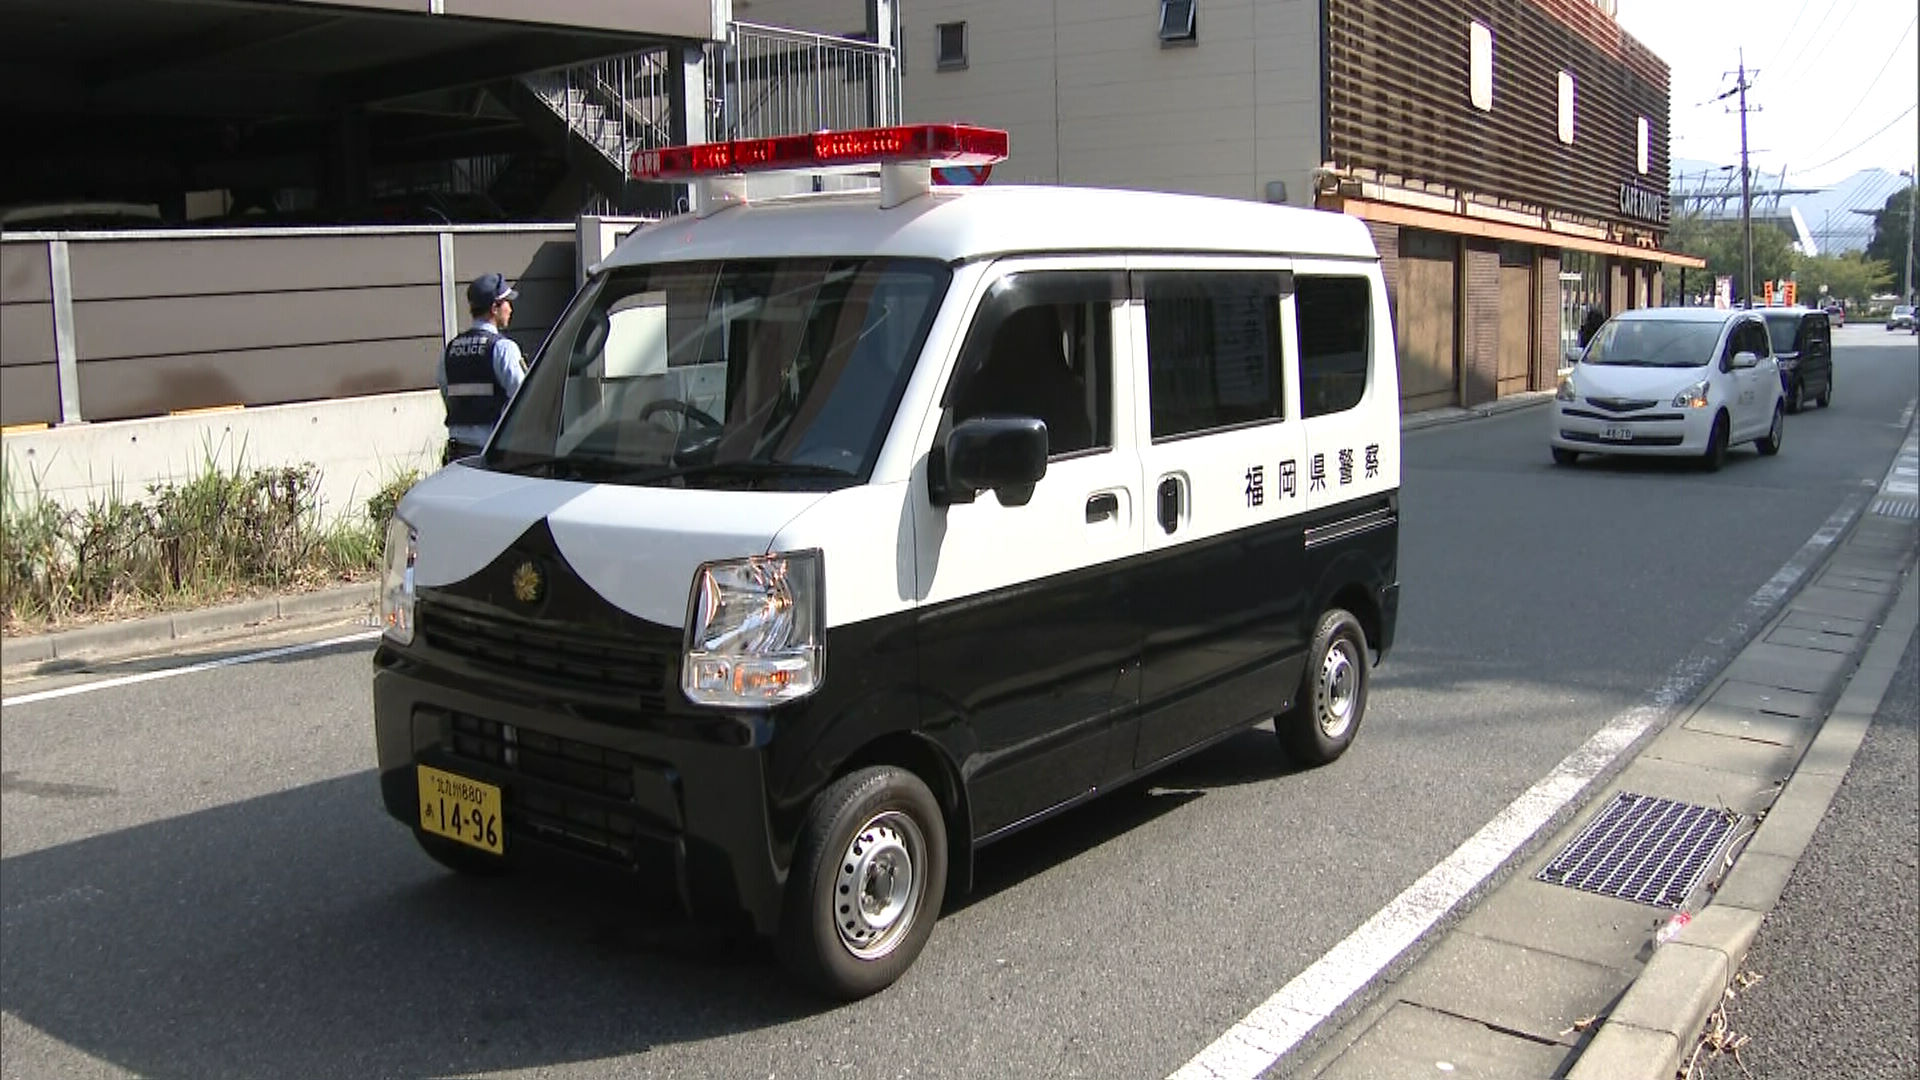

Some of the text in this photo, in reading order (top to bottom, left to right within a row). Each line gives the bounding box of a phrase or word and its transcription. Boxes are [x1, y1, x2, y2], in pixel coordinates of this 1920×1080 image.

[449, 343, 487, 356] POLICE
[1245, 443, 1379, 508] 福岡県警察
[440, 797, 498, 847] 14-96
